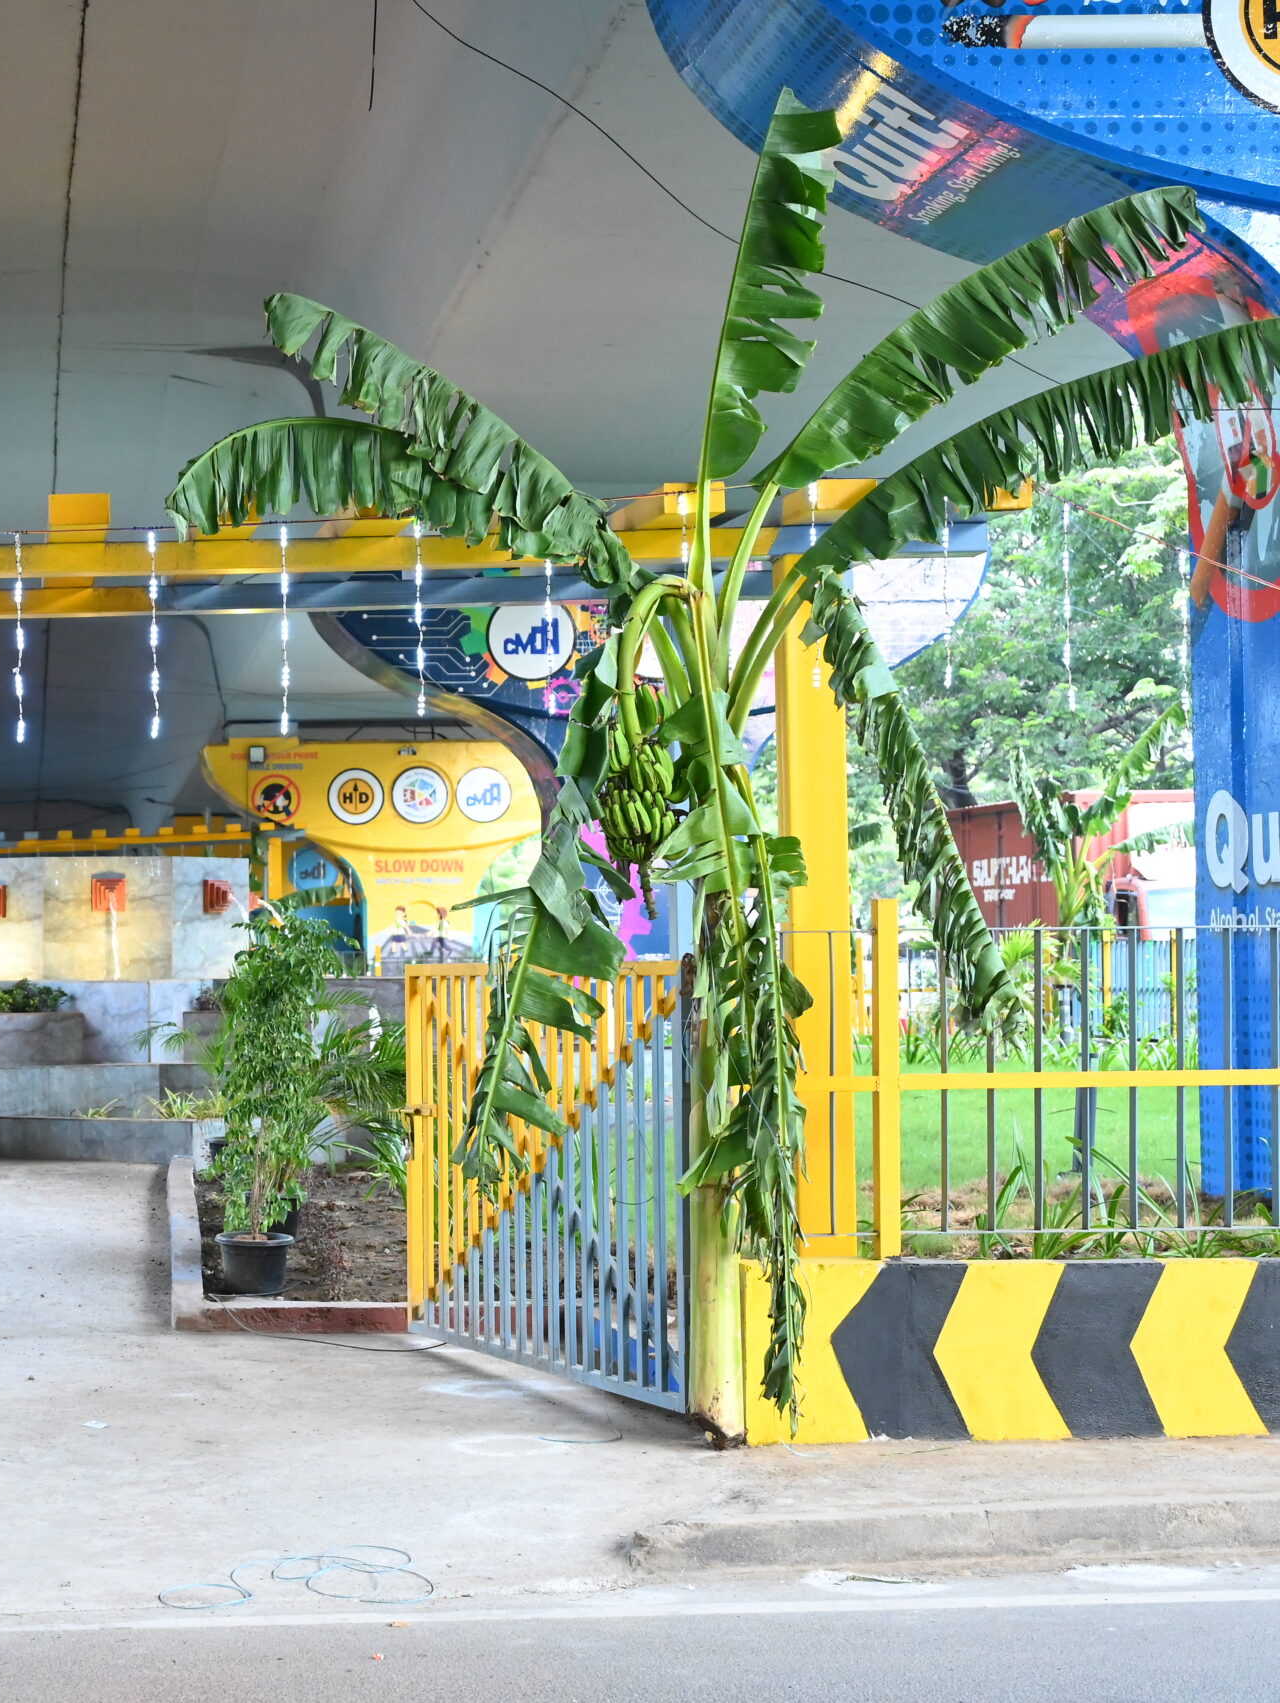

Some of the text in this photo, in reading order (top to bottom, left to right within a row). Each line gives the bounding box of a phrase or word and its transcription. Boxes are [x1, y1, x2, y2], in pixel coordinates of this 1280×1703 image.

[821, 83, 970, 201] Quit!
[947, 162, 984, 193] Start
[375, 859, 464, 873] SLOW DOWN
